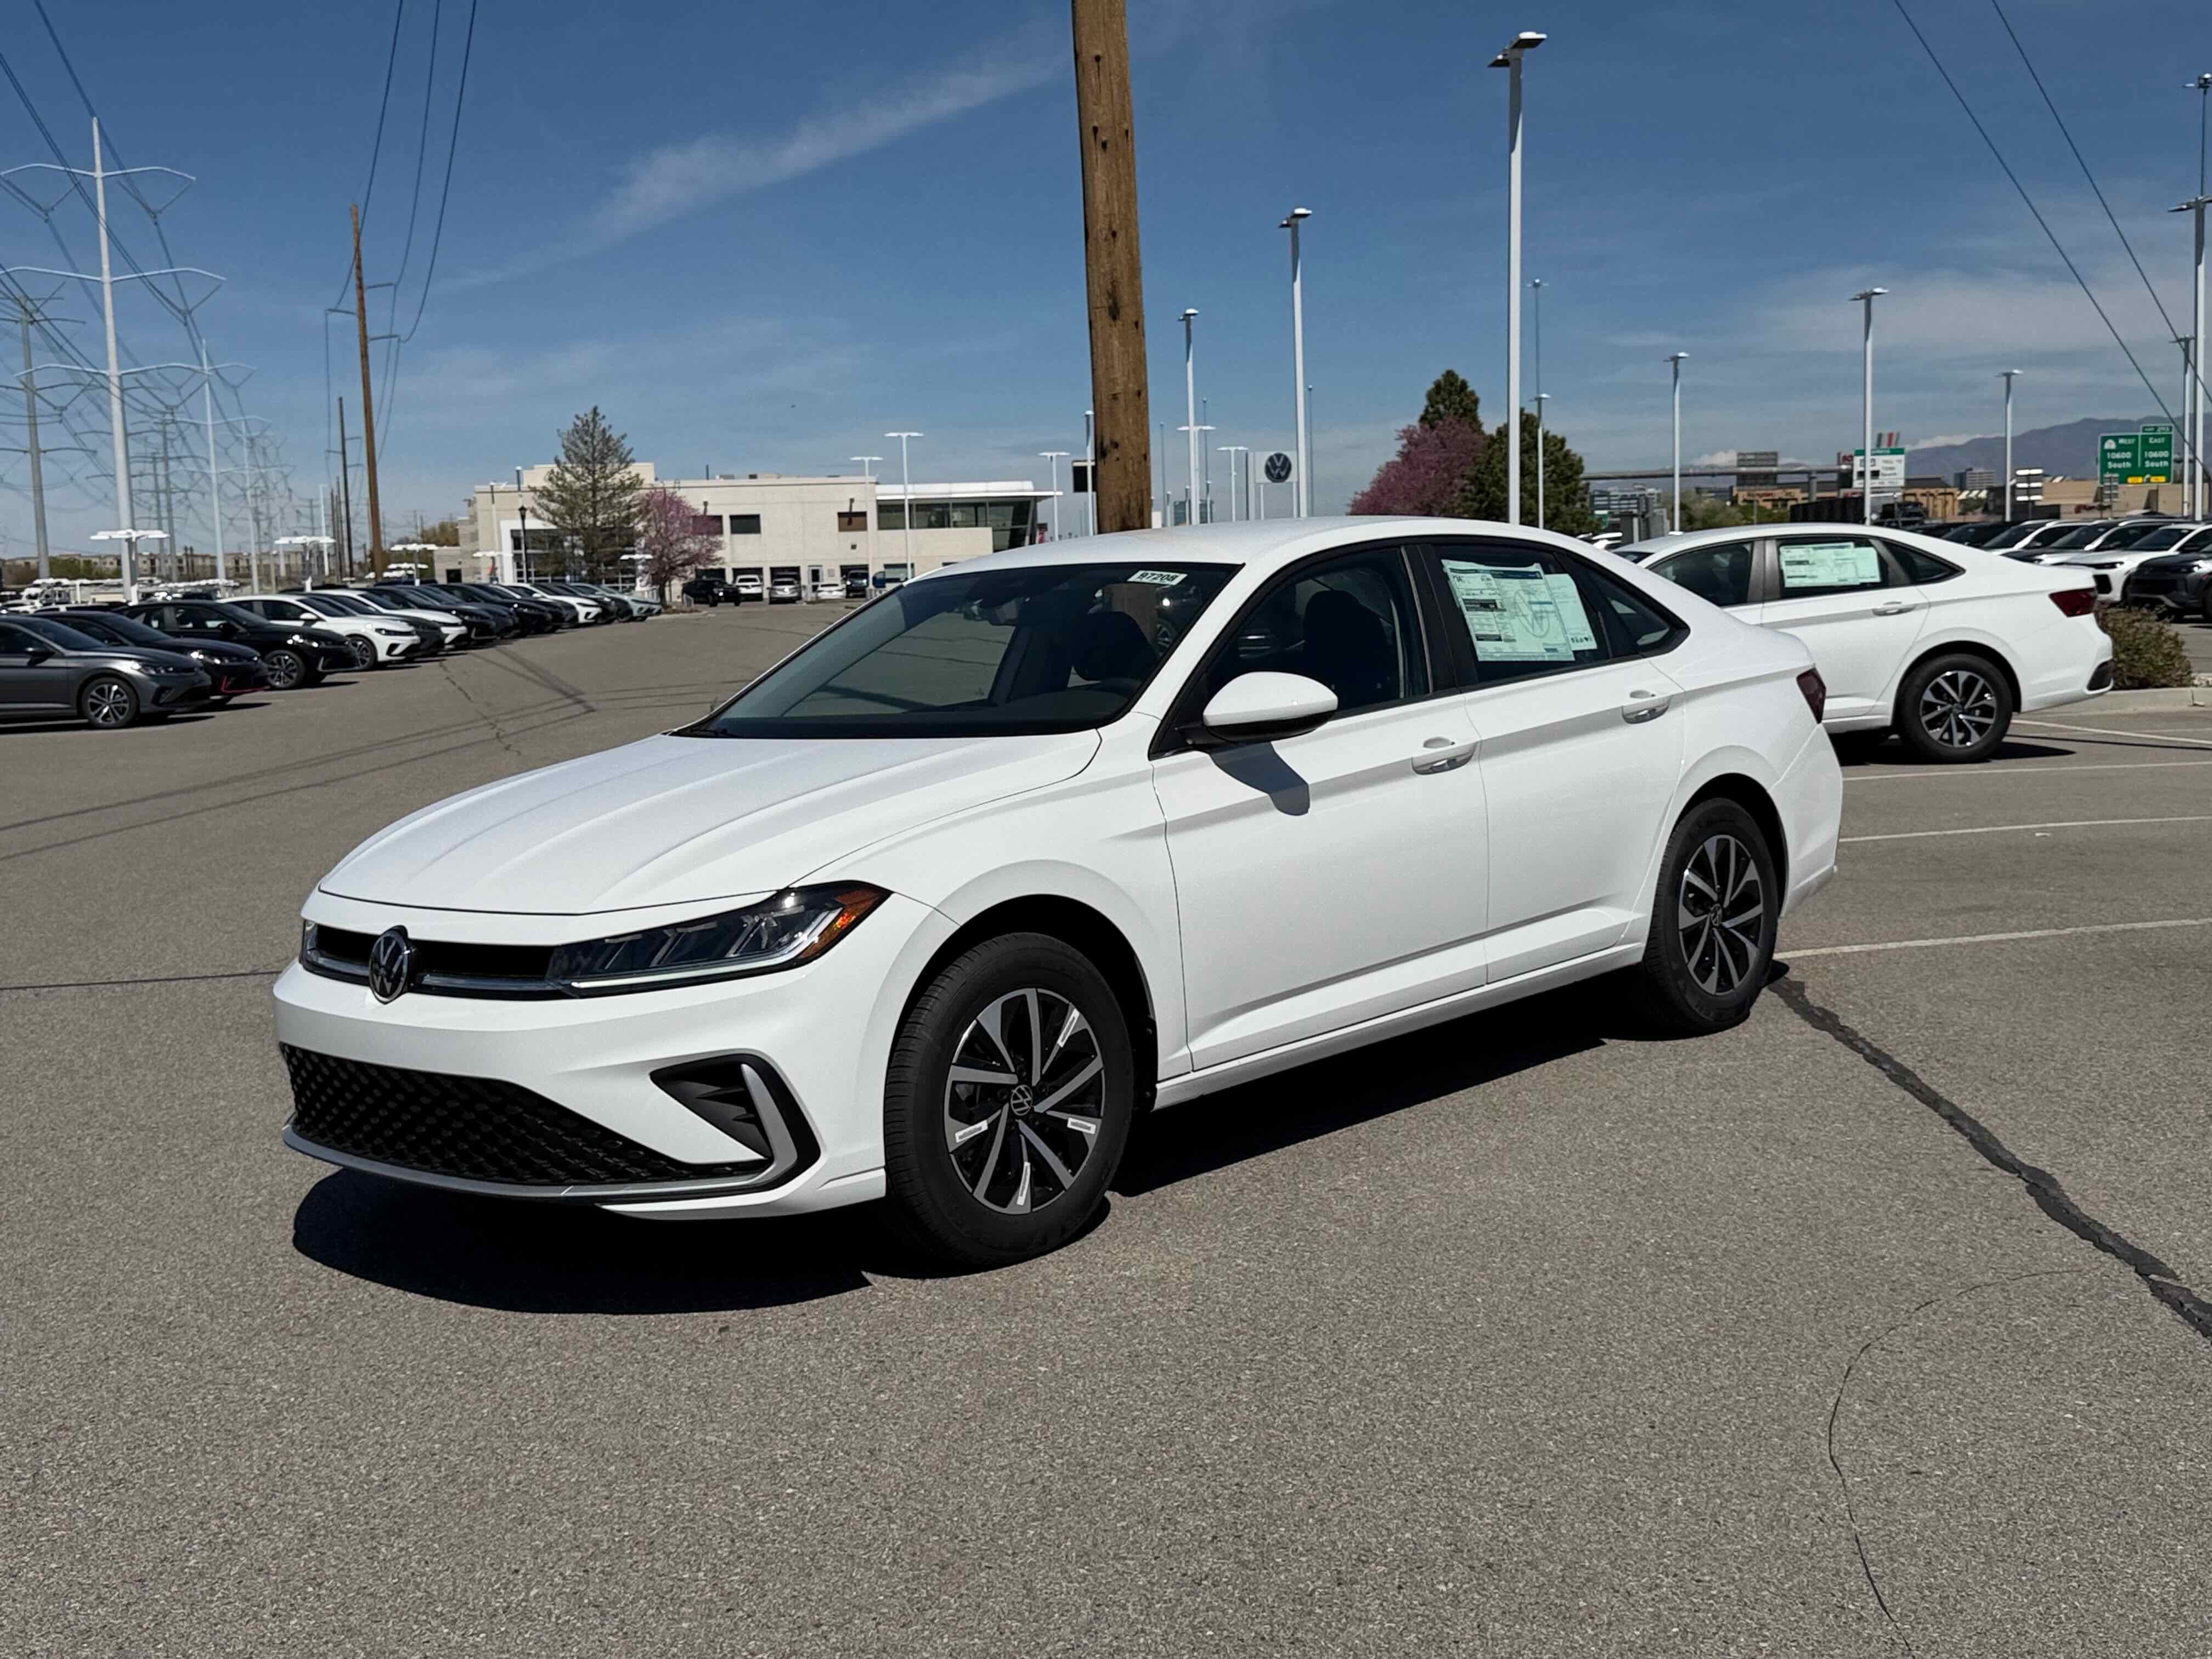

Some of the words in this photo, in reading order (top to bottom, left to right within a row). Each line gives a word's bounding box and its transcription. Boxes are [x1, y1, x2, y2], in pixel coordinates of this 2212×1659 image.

[1266, 453, 1291, 481] VW
[2144, 460, 2169, 468] South
[369, 932, 408, 1000] VW
